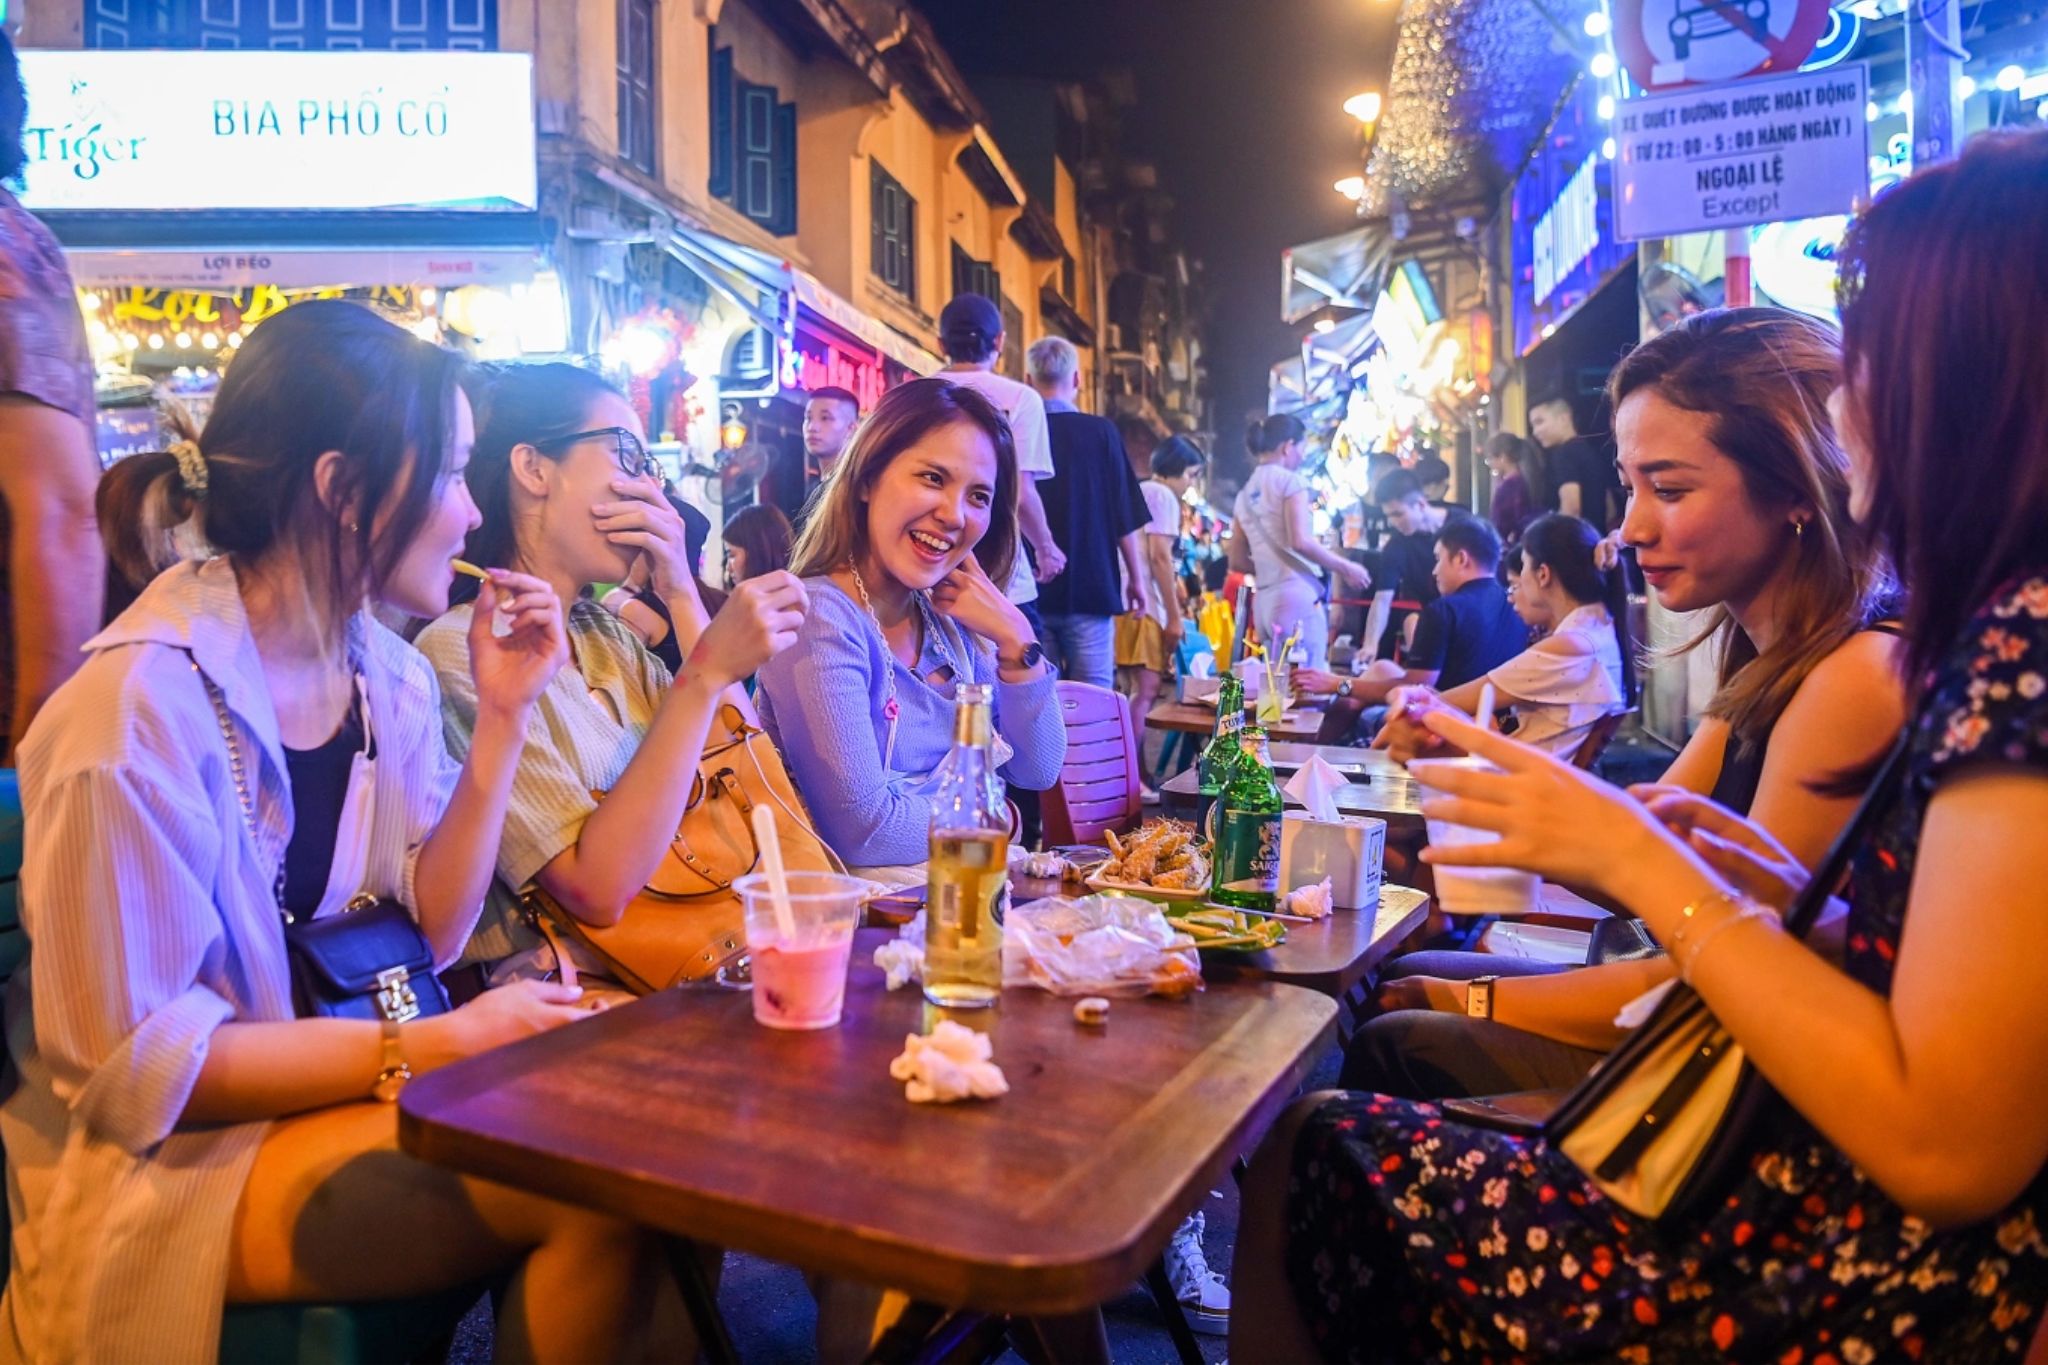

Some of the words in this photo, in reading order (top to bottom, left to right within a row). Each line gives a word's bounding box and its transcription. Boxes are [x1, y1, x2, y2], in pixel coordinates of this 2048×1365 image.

[1775, 89, 1811, 110] HOẠT
[1816, 81, 1857, 106] ĐỘNG
[213, 99, 281, 136] BIA
[299, 86, 383, 136] PHỐ
[397, 85, 449, 137] CỔ
[1758, 122, 1797, 146] HÀNG
[1802, 117, 1841, 140] NGÀY
[26, 123, 147, 180] Tiger
[1696, 163, 1756, 192] NGOẠI
[1762, 153, 1784, 186] LỆ
[1703, 192, 1780, 219] Except
[1249, 860, 1280, 872] SAIGO
